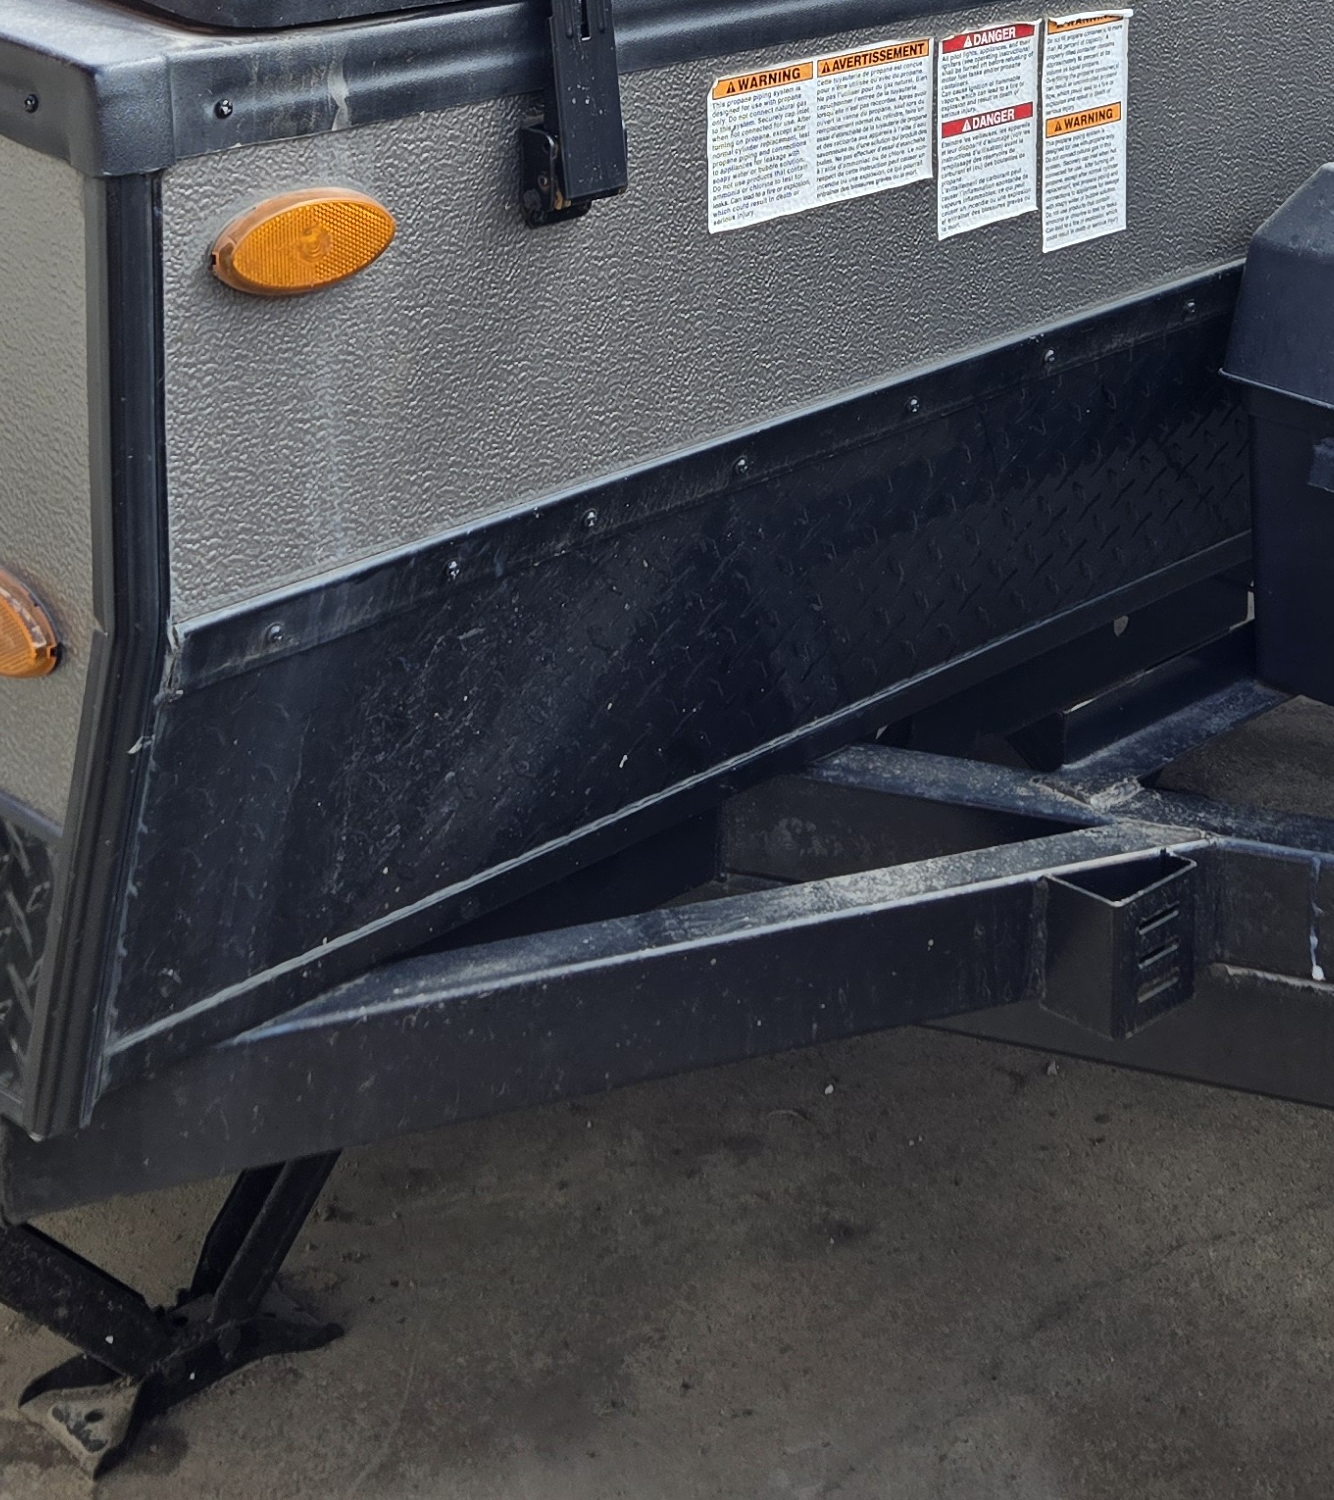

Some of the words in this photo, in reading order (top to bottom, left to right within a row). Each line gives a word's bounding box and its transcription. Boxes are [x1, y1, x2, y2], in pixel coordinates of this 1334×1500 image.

[973, 26, 1016, 46] DANGER
[832, 43, 925, 71] AVERTISSEMENT
[738, 68, 801, 91] WARNING
[972, 108, 1015, 130] DANGER
[1064, 108, 1113, 129] WARNING
